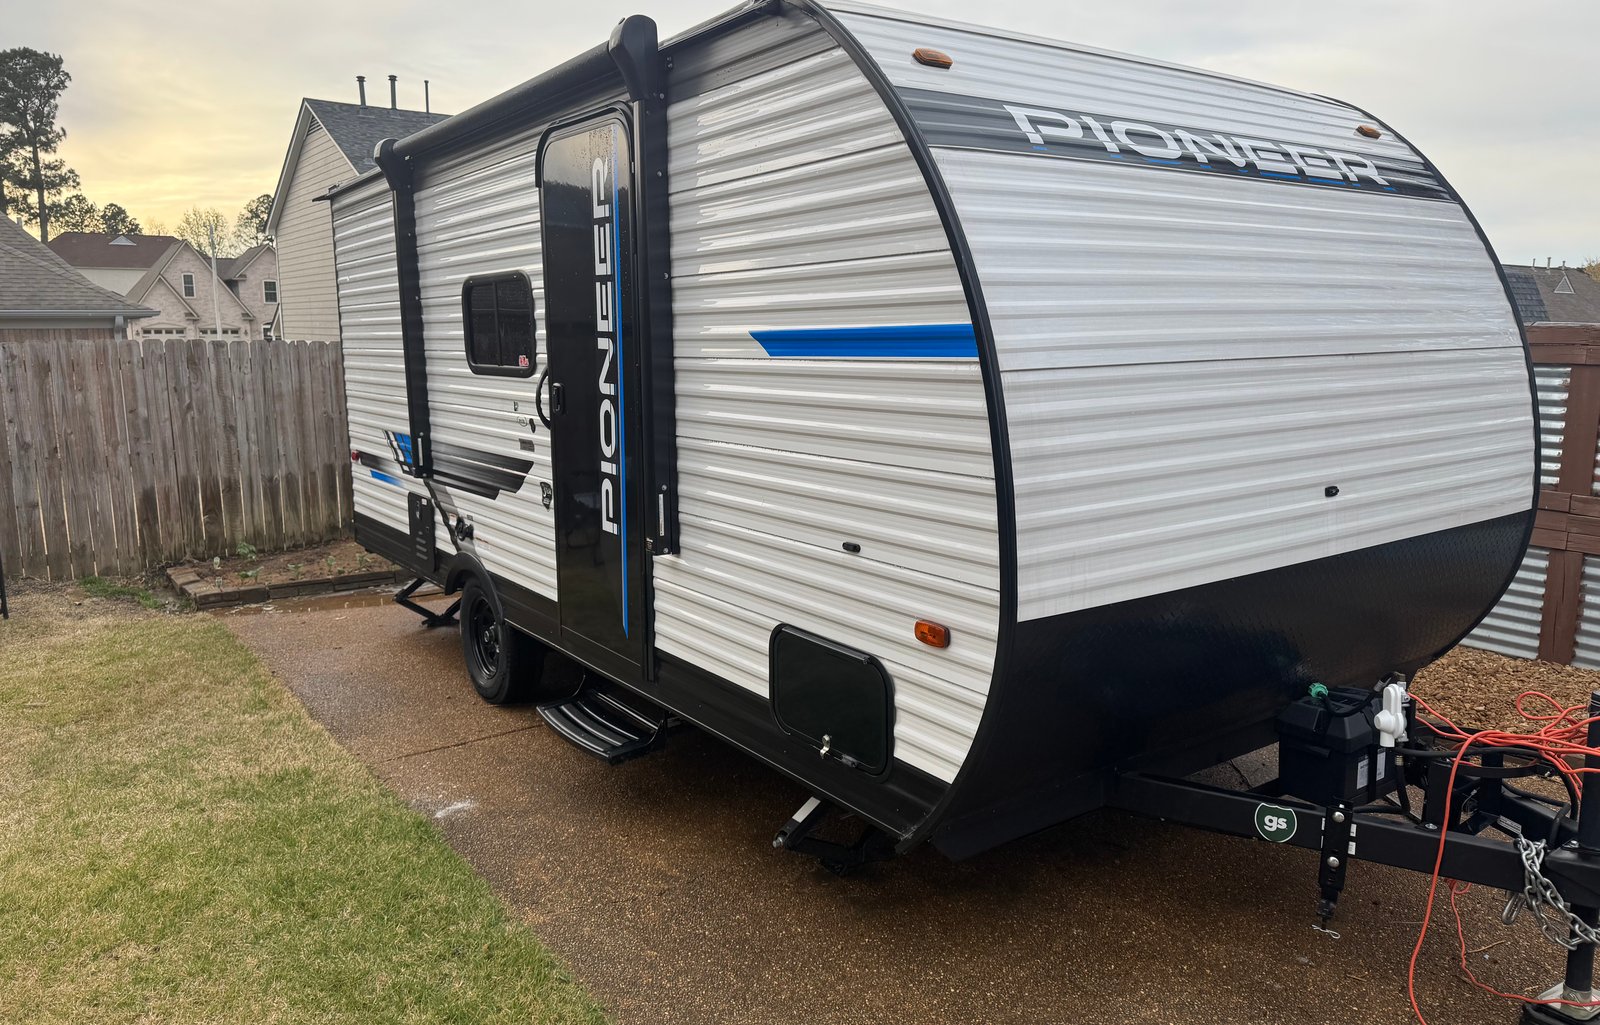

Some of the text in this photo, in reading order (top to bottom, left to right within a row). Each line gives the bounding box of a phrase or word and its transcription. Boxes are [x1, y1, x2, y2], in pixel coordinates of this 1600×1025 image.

[1002, 104, 1390, 186] PIONEER
[592, 157, 618, 536] PIONEER
[1263, 815, 1288, 832] gs
